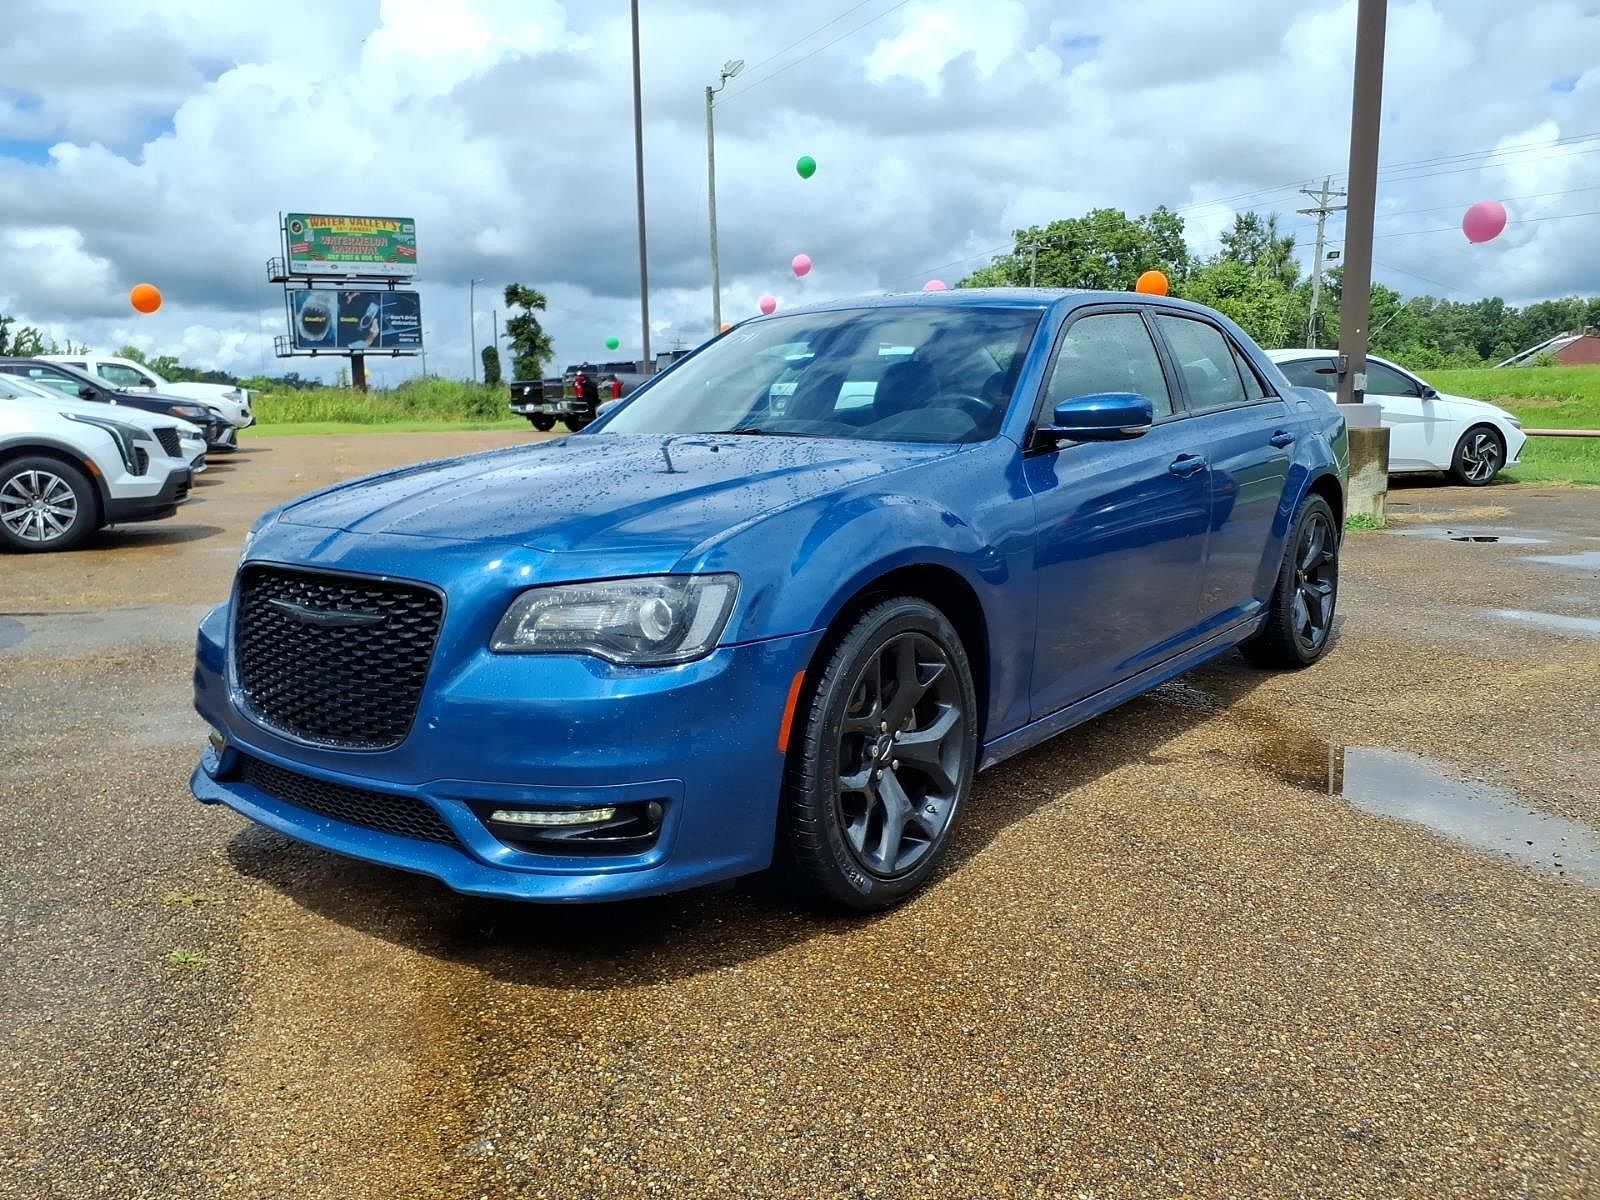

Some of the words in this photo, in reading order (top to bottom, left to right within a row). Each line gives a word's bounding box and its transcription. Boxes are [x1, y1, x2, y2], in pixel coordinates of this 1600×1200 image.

[310, 216, 345, 227] WATER
[349, 218, 397, 231] VALLEY'S
[320, 235, 388, 247] WATERMELON
